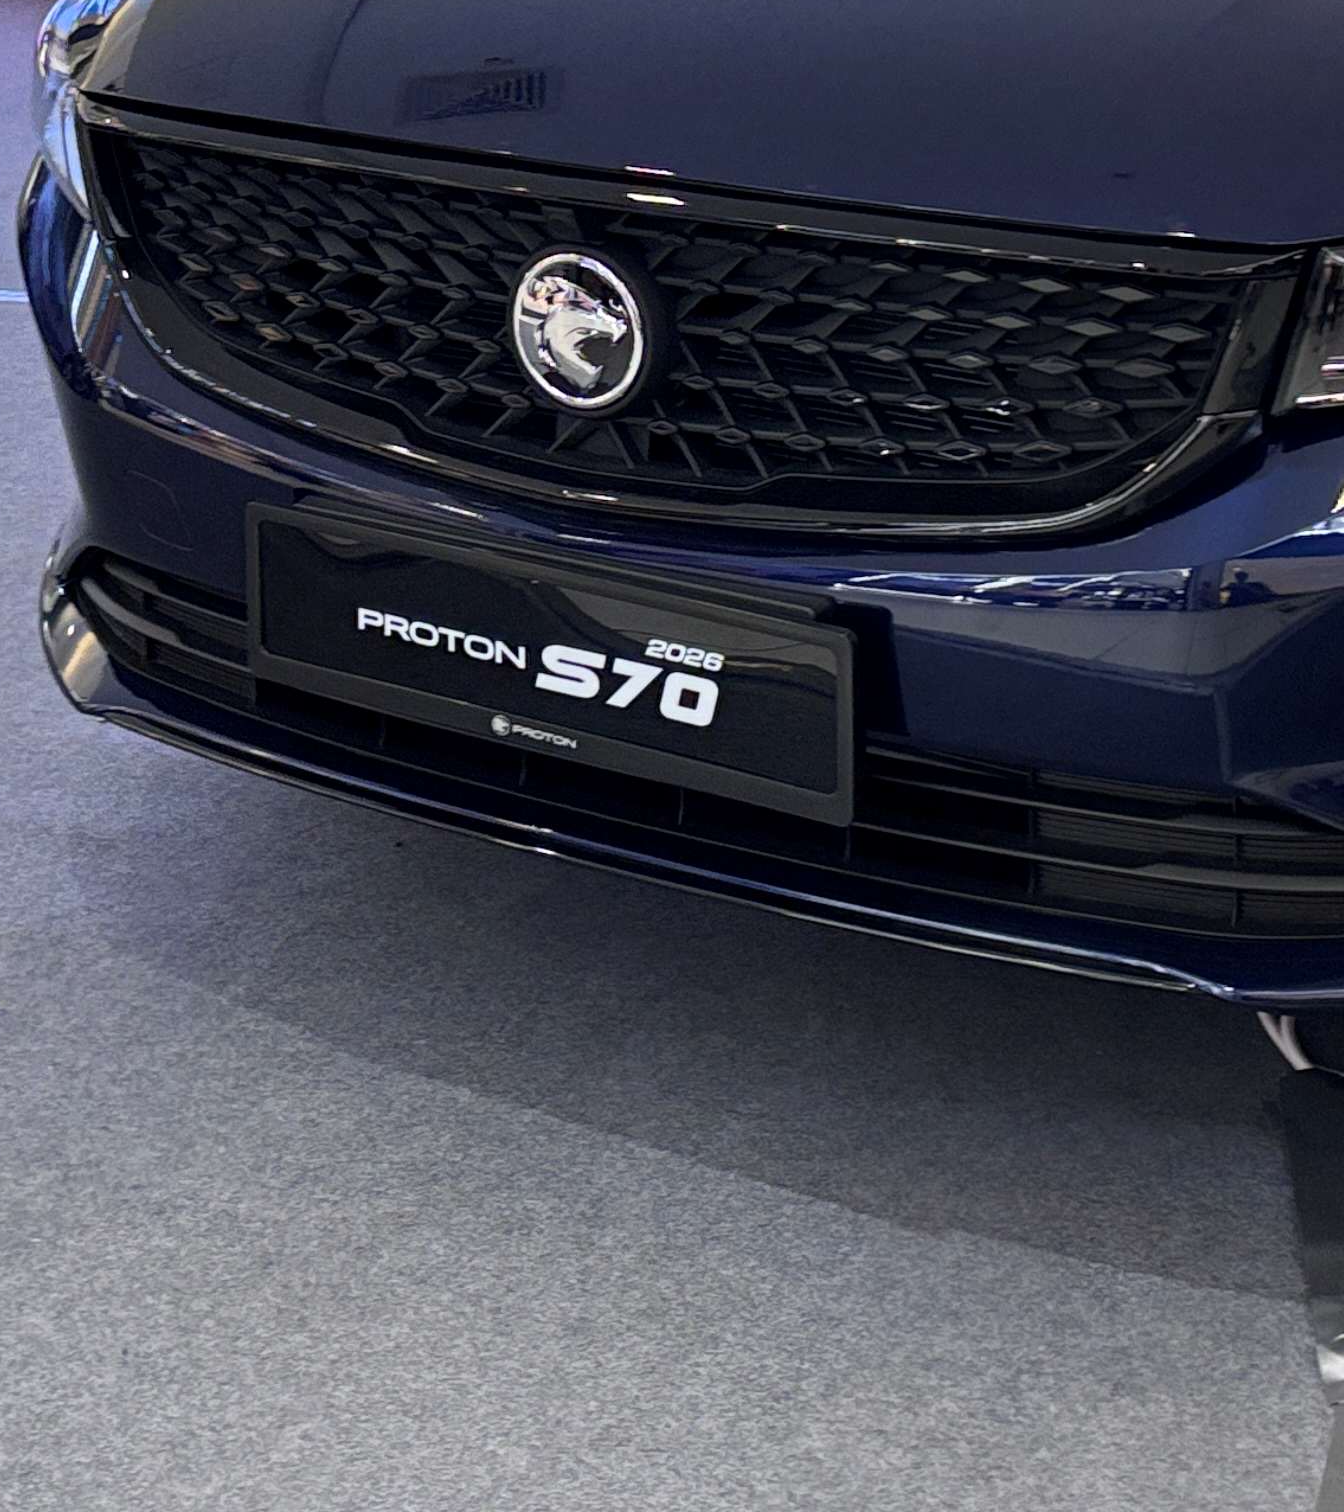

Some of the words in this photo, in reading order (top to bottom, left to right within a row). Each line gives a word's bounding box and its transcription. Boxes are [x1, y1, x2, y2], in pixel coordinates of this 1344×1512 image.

[357, 606, 527, 670] PROTON
[535, 643, 720, 728] S70
[644, 638, 725, 673] 2026
[511, 723, 578, 750] PROTON
